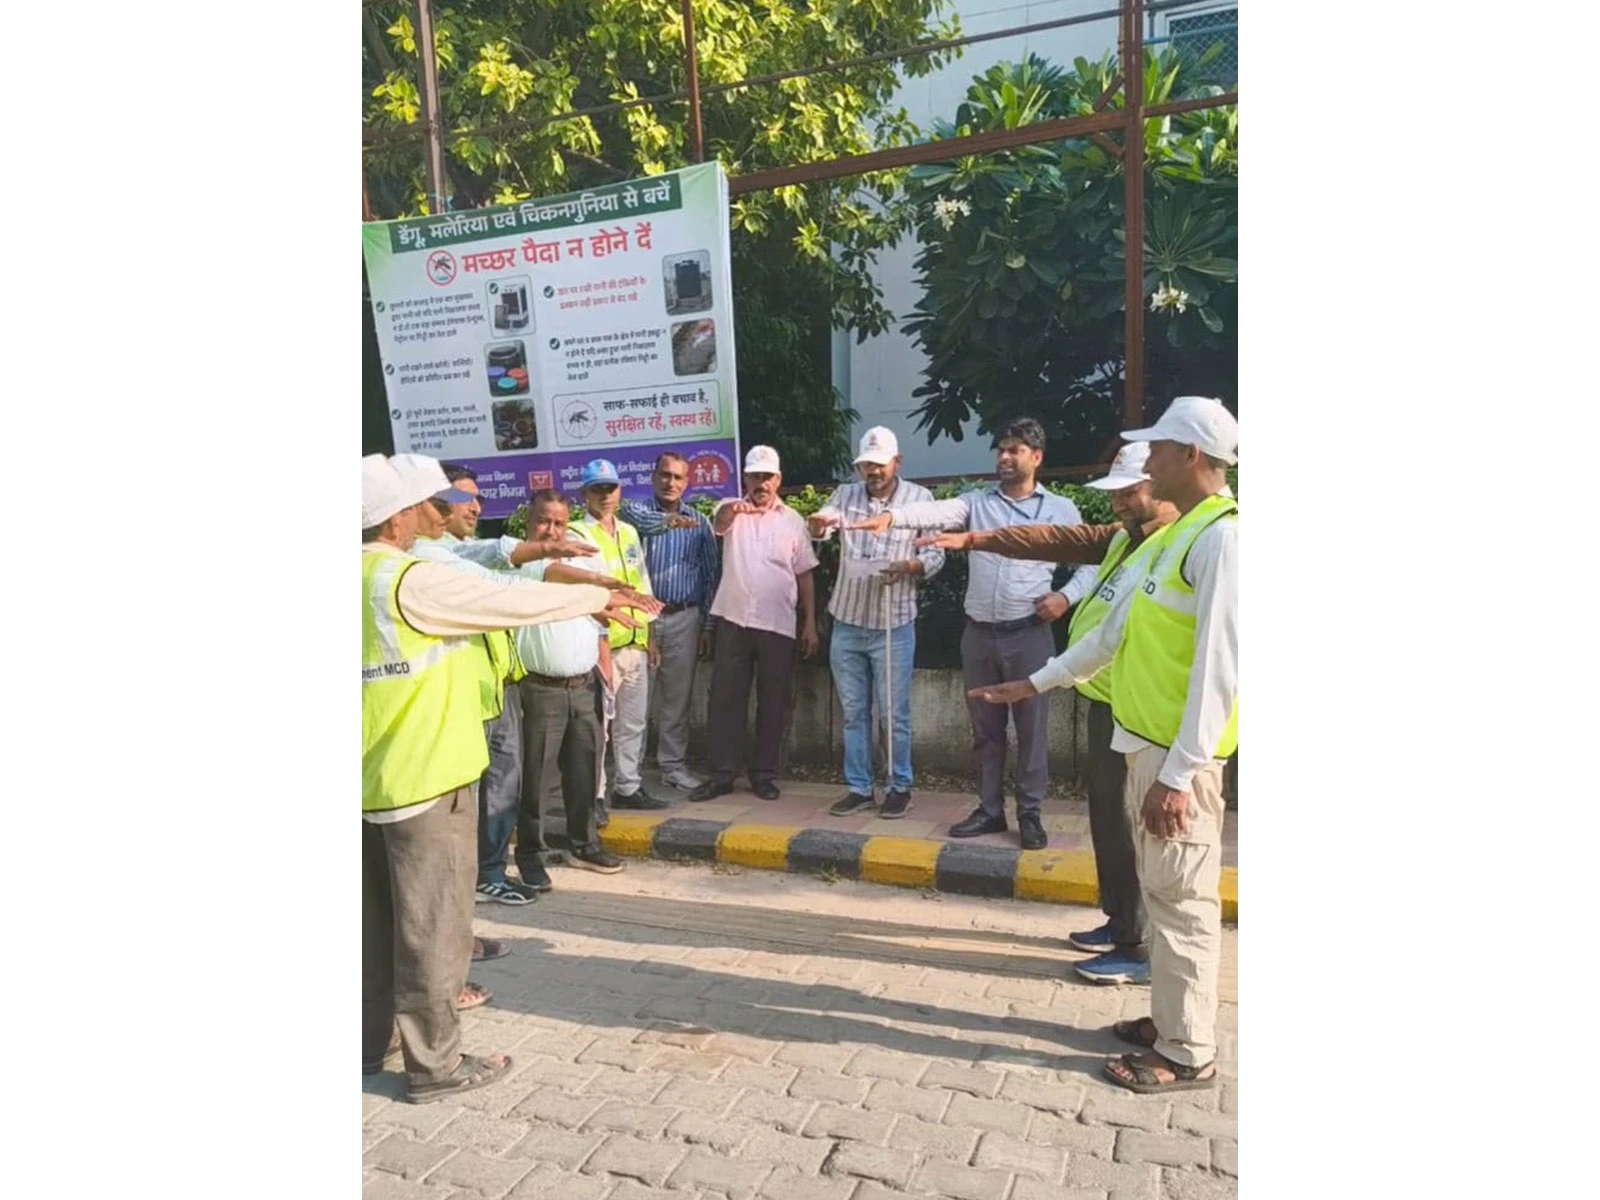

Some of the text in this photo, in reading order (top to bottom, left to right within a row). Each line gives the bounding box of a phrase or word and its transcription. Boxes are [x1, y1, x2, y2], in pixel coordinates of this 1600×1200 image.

[428, 214, 489, 240] मलेरिया
[492, 206, 517, 229] एवं
[520, 192, 619, 224] चिकनगुनिया
[622, 186, 639, 208] से
[642, 180, 672, 203] बचें
[461, 221, 653, 273] मच्छर पैदा न होने दें
[602, 394, 657, 411] साफ-सफाई
[660, 393, 670, 408] ही
[672, 392, 697, 404] बचाव
[605, 414, 646, 437] सुरक्षित
[669, 413, 697, 427] स्वस्थ
[499, 483, 526, 498] निगम
[384, 661, 410, 676] MCD
